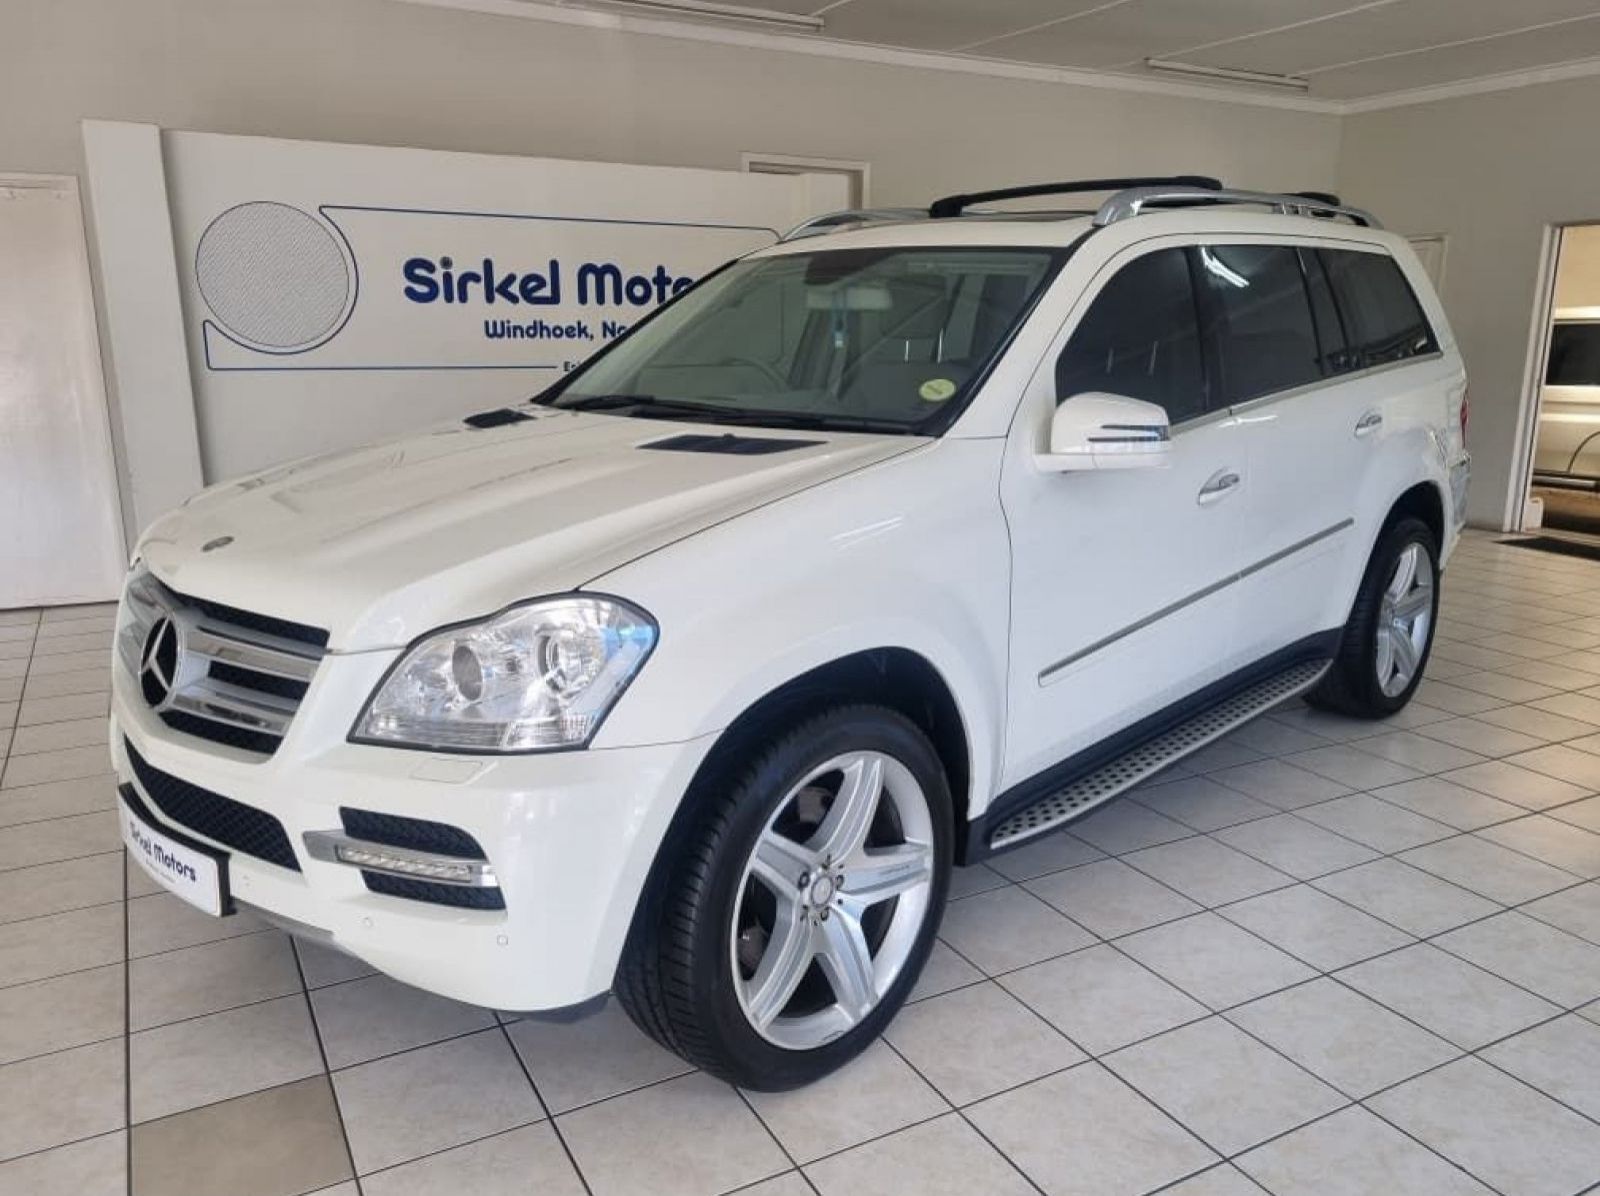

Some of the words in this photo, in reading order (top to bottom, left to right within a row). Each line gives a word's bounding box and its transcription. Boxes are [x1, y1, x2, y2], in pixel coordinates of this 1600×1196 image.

[403, 256, 561, 305] Sirkel
[484, 319, 594, 341] Windhoek,
[153, 843, 196, 882] Motors
